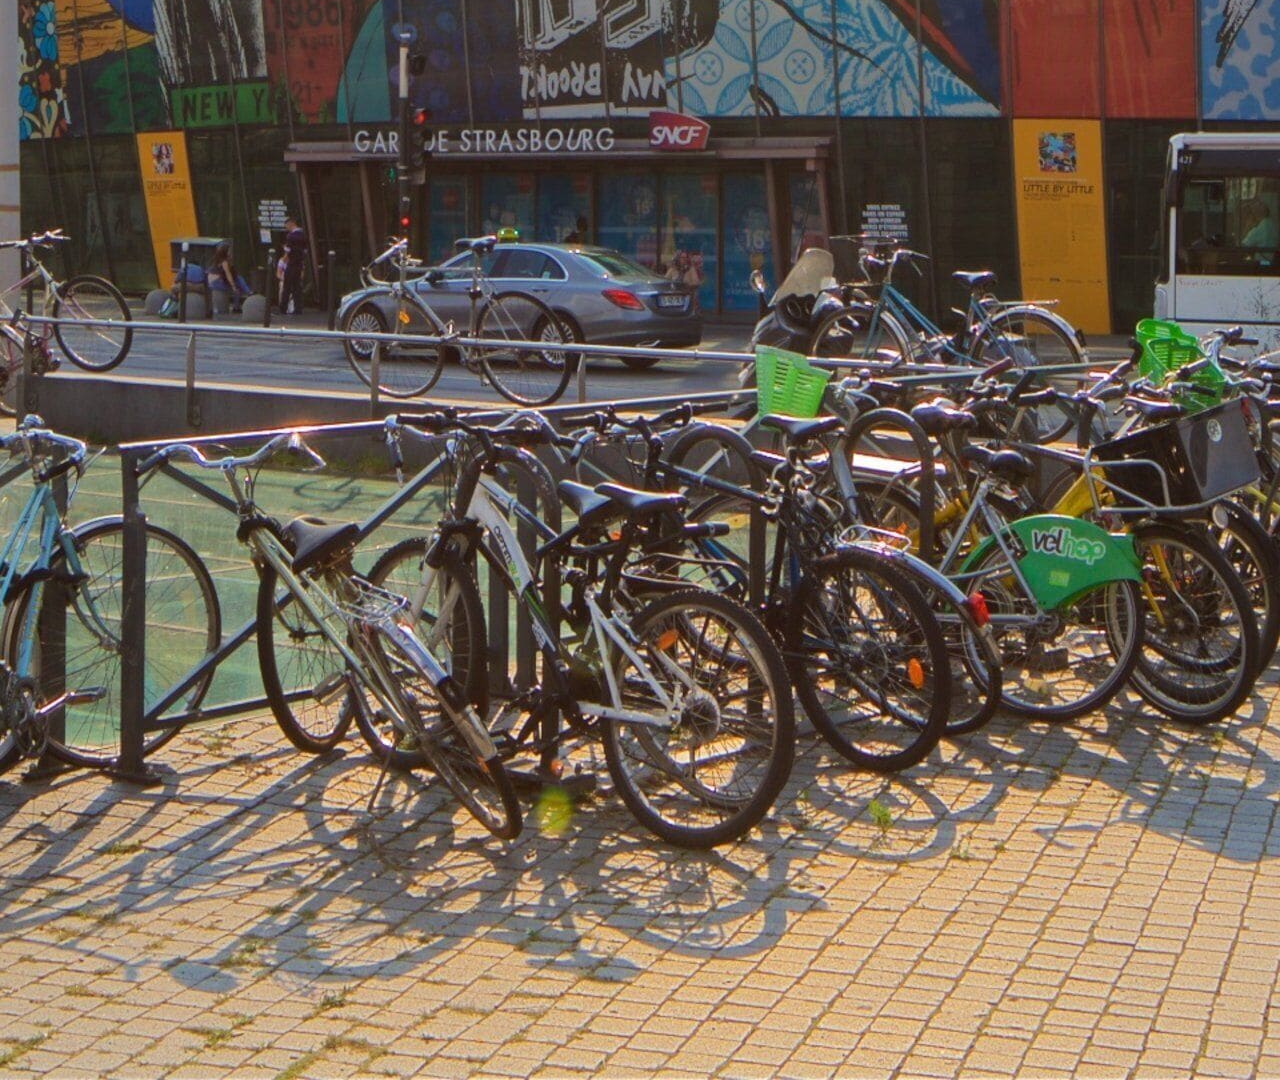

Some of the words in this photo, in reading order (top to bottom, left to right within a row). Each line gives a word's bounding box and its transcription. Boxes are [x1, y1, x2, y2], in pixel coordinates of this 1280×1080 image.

[181, 89, 238, 124] NEW
[353, 129, 401, 153] GAR
[458, 127, 616, 153] STRASBOURG
[650, 125, 703, 146] SNCF
